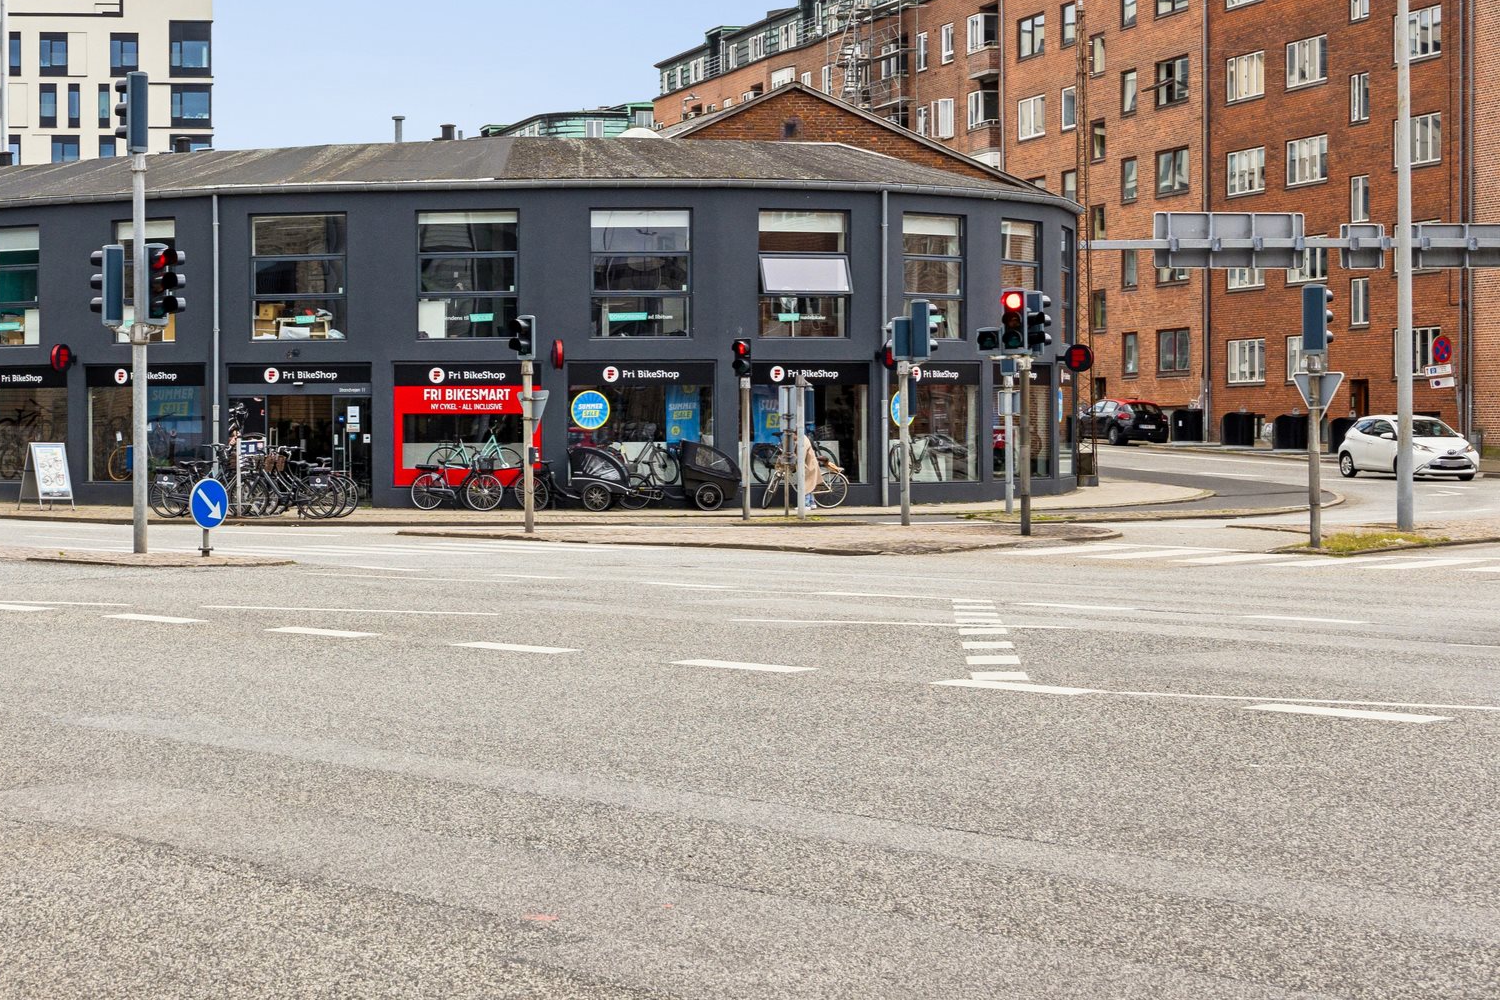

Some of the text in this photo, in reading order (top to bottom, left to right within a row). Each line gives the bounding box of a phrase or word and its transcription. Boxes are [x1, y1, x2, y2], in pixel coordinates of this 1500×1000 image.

[1, 374, 11, 382] Fri
[12, 374, 43, 384] BikeShop
[146, 371, 177, 381] ikeShop
[282, 371, 295, 379] Fri
[297, 371, 338, 380] BikeShop
[448, 371, 461, 379] Fri
[463, 371, 506, 381] BikeShop
[622, 370, 635, 378] Fri
[637, 370, 680, 380] BikeShop
[787, 369, 799, 378] Fri
[801, 369, 839, 379] BikeShop
[923, 370, 959, 379] Fri BikeShop
[423, 388, 511, 401] FRI BIKESMART
[577, 402, 603, 410] SUMMER
[668, 402, 697, 411] SUMMER
[674, 411, 692, 419] SALE
